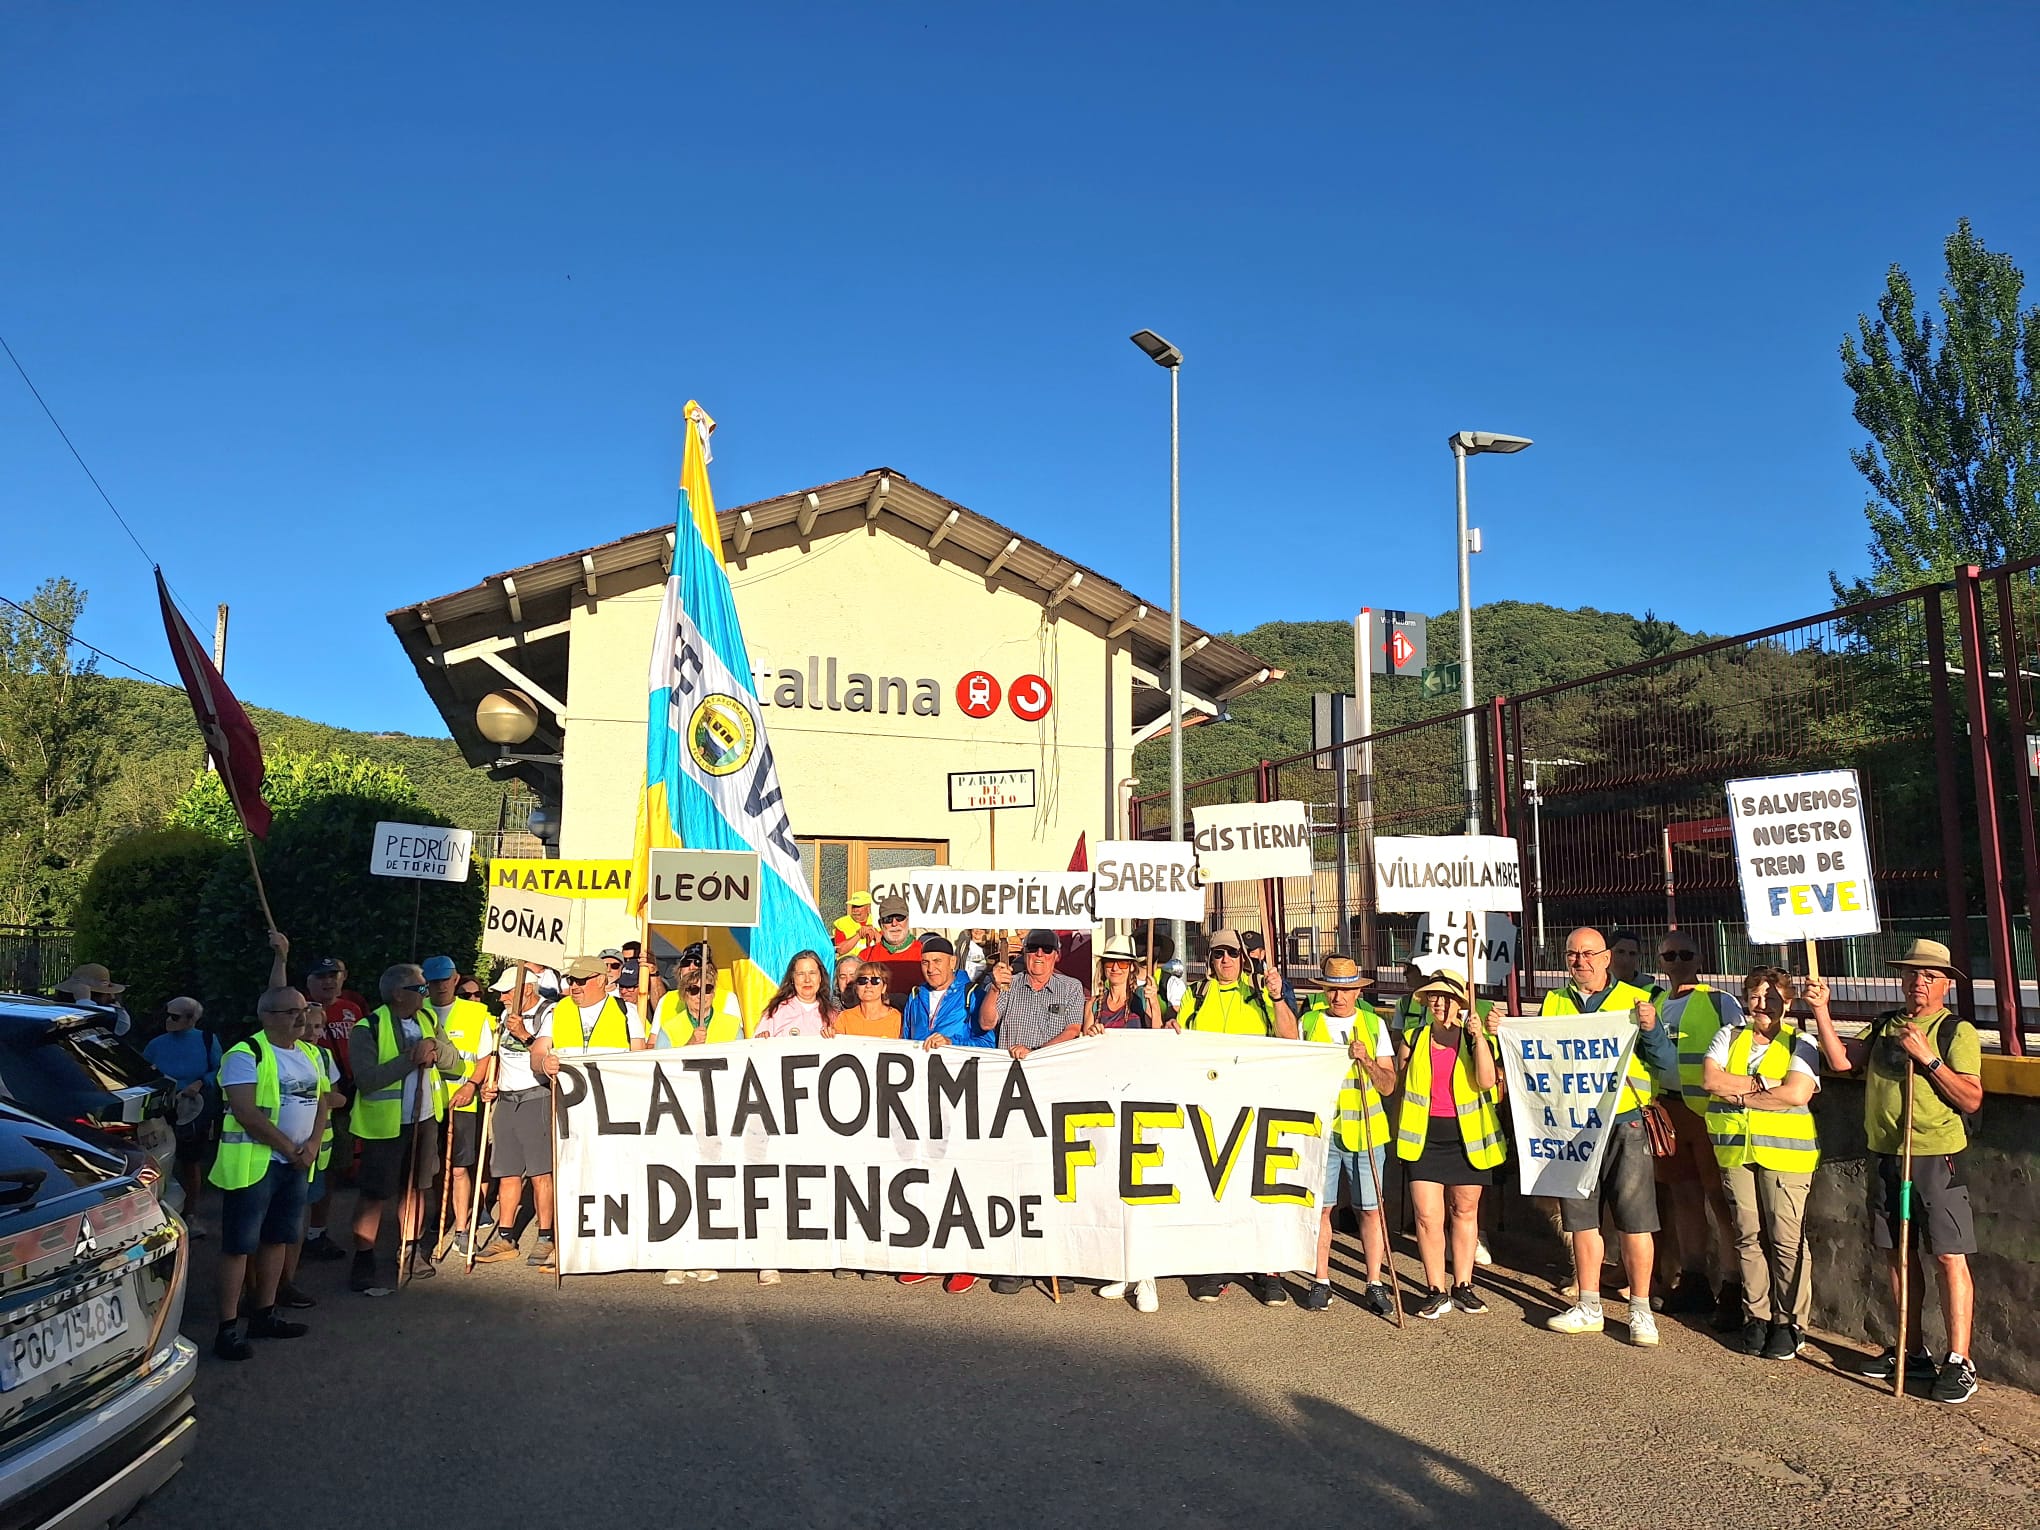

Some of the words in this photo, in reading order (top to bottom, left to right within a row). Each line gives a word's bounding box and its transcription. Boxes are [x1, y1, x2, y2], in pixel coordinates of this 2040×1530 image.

[751, 656, 940, 716] tallana
[958, 774, 1028, 786] PARDAVE
[982, 785, 1001, 795] DE
[1195, 822, 1311, 851] CISTIERNA
[1753, 819, 1852, 846] NUESTRO
[386, 834, 466, 863] PEDRÚN
[386, 860, 398, 870] DE
[1751, 854, 1805, 877] TREN
[1817, 851, 1845, 872] DE
[499, 868, 632, 891] MATALLAN
[655, 871, 750, 902] LEÓN
[871, 883, 910, 906] GAR
[487, 905, 564, 945] BOÑAR
[1521, 1040, 1552, 1060] EL
[1557, 1037, 1619, 1060] TREN
[1524, 1071, 1551, 1093] DE
[1562, 1071, 1618, 1094] FEVE
[556, 1052, 1047, 1140] PLATAFORMA
[1544, 1106, 1557, 1127] A
[1569, 1107, 1602, 1129] LA
[1052, 1101, 1322, 1208] FEVE
[1529, 1138, 1595, 1162] ESTAC
[578, 1193, 629, 1238] EN
[646, 1164, 984, 1249] DEFENSA
[987, 1195, 1043, 1238] DE
[13, 1327, 57, 1370] PGC
